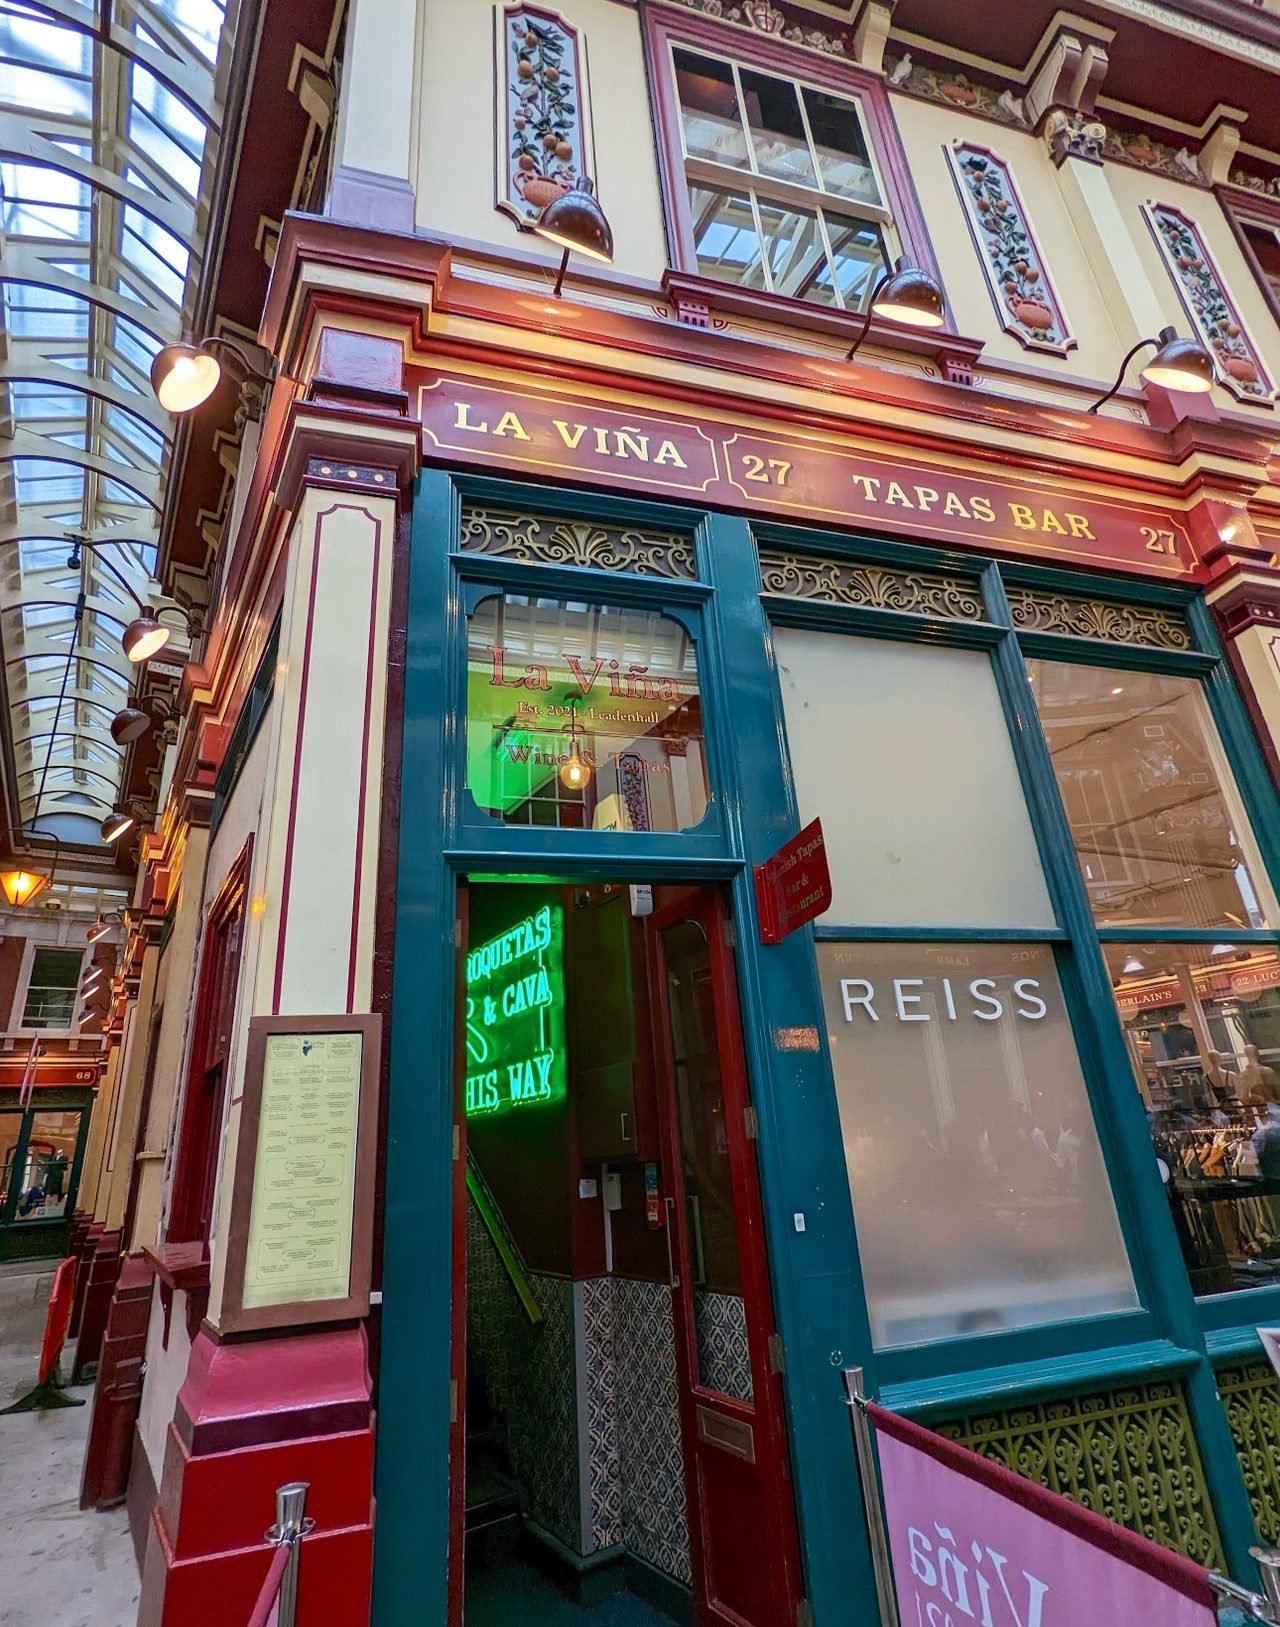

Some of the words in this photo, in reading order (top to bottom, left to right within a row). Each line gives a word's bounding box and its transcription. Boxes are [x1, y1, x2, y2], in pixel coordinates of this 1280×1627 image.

[454, 402, 531, 441] LA
[553, 420, 687, 468] VIÑA
[742, 455, 792, 485] 27
[852, 475, 997, 523] TAPAS
[1008, 502, 1096, 541] BAR
[1139, 527, 1178, 555] 27
[487, 645, 552, 691] La
[562, 653, 682, 702] Viña
[518, 701, 543, 714] Est.
[548, 704, 578, 717] 2021
[589, 707, 660, 723] Leadenhall
[505, 745, 569, 765] Wine
[608, 752, 671, 774] Tapas
[796, 835, 823, 860] Tapas
[1254, 969, 1280, 983] LUC
[484, 995, 497, 1025] &
[503, 970, 549, 1017] CAVA
[840, 979, 1047, 1021] REISS
[508, 1054, 550, 1100] WAY
